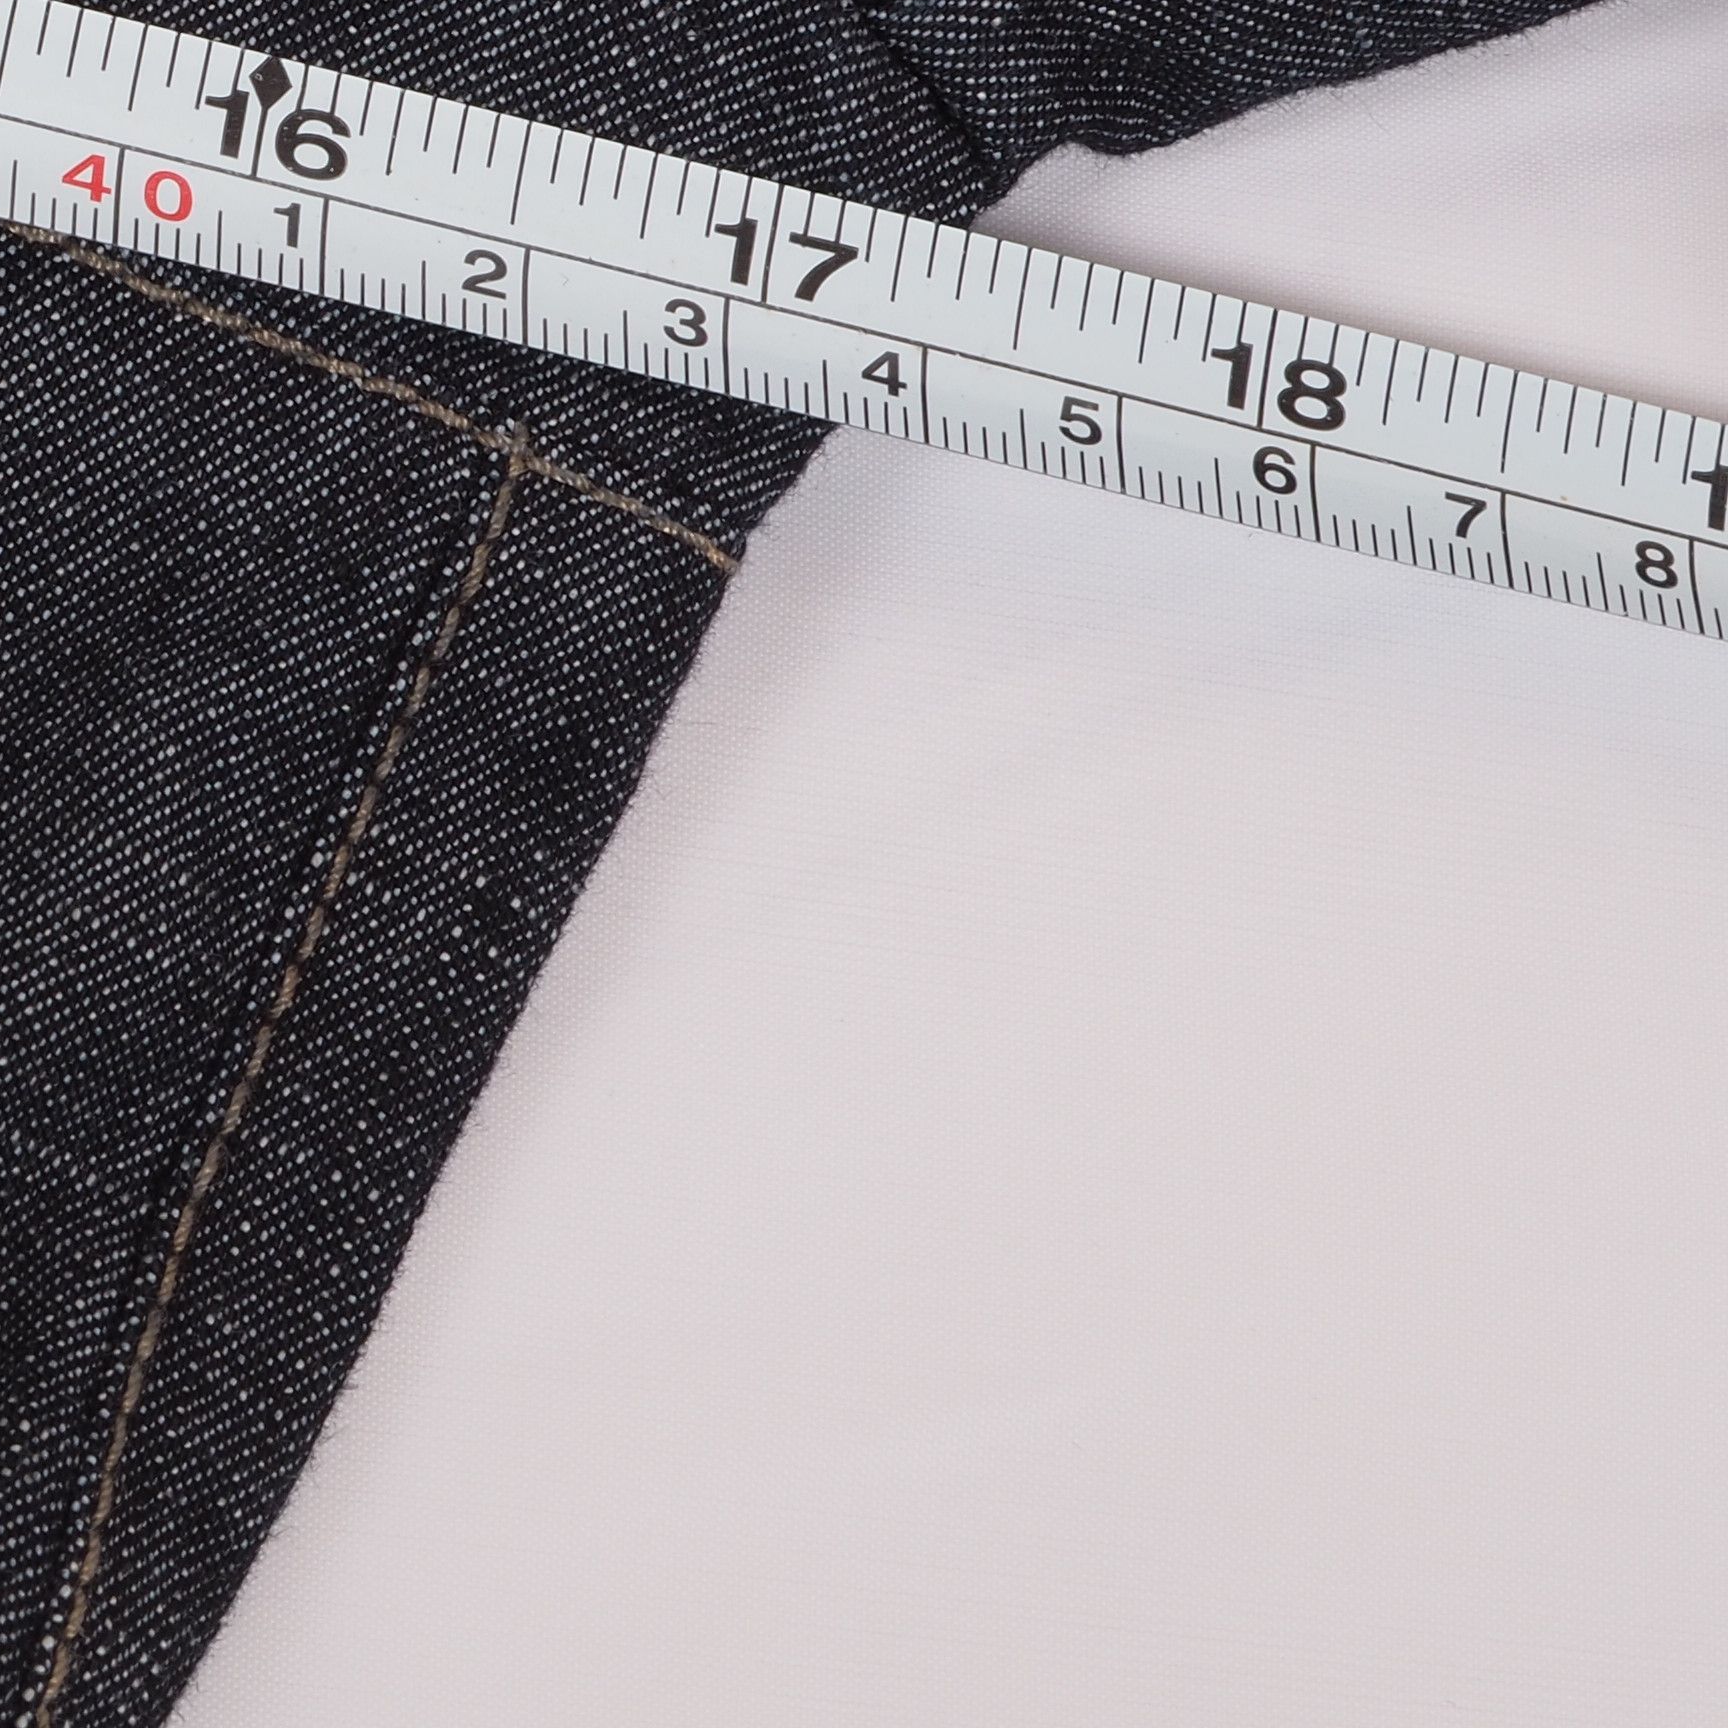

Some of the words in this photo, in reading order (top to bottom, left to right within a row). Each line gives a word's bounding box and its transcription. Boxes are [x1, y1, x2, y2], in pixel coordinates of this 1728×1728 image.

[61, 153, 194, 223] 40
[273, 202, 302, 249] 1
[460, 249, 509, 301] 2
[662, 298, 709, 348] 3
[860, 349, 908, 398] 4
[1057, 395, 1104, 447] 5
[1253, 445, 1299, 496] 6
[1444, 491, 1489, 540] 7
[1635, 539, 1679, 591] 8
[206, 89, 352, 181] 16
[714, 216, 859, 303] 17
[1210, 341, 1348, 432] 18
